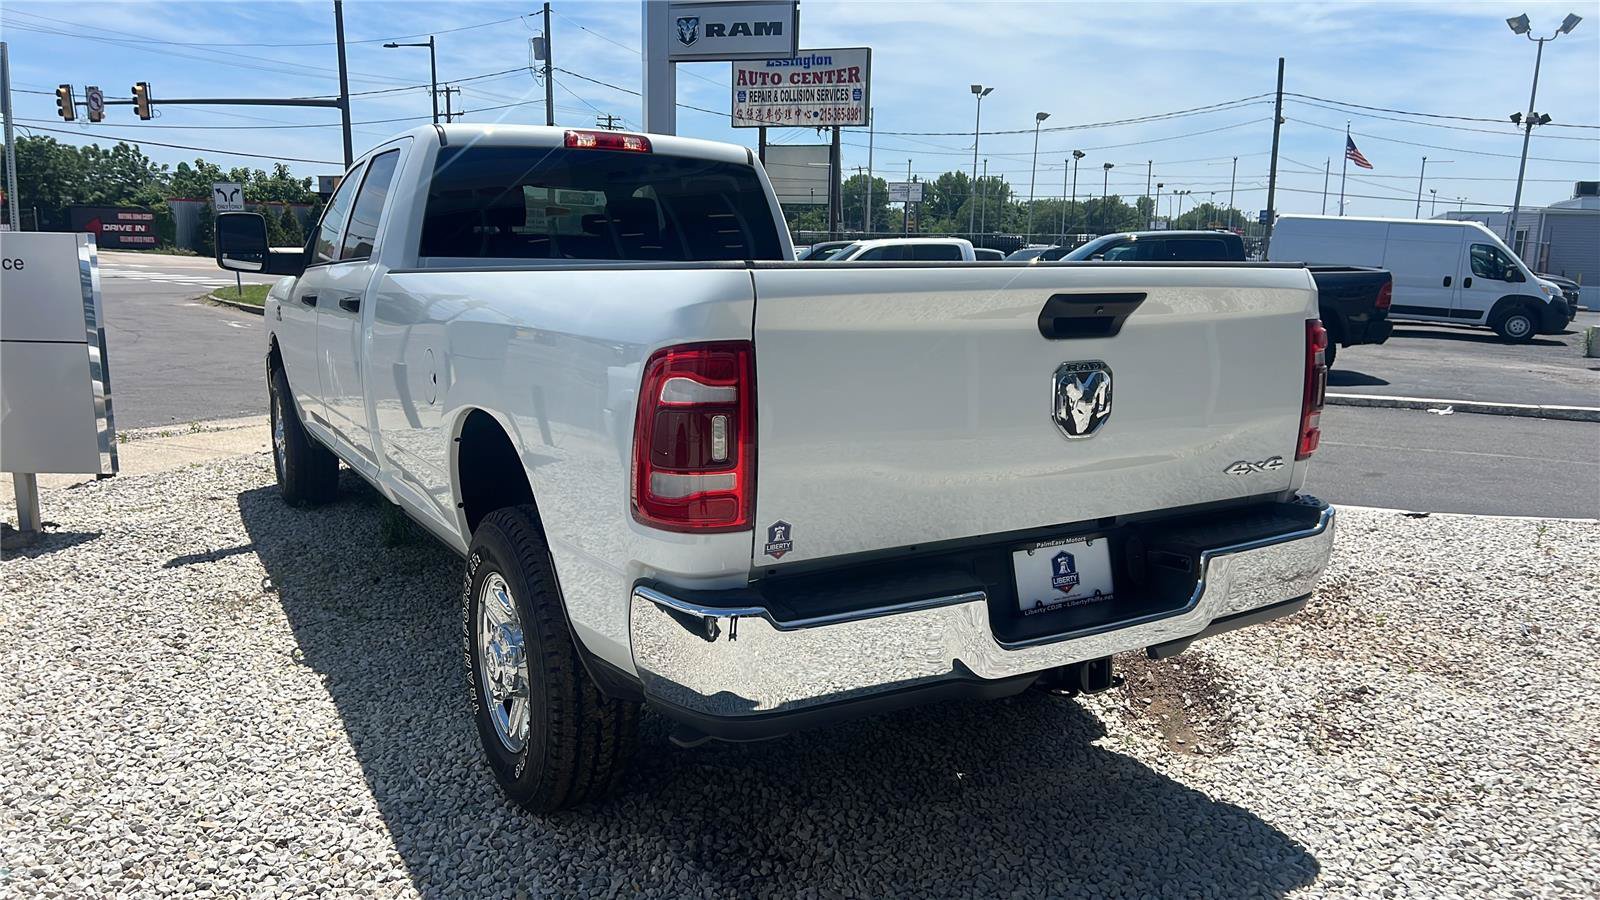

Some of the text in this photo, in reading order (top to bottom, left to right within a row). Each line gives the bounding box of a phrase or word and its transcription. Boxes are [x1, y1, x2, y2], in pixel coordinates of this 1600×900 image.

[705, 22, 783, 38] RAM
[737, 66, 861, 86] AUTO CENTER
[749, 90, 772, 102] REPAIR
[773, 90, 779, 102] &
[780, 89, 815, 102] COLLISION
[816, 88, 849, 102] SERVICES
[102, 224, 132, 232] DRIVE
[766, 542, 791, 551] LIBERTY
[1036, 536, 1086, 549] PalmEasy Motors
[1053, 574, 1078, 585] LIBERTY
[1024, 606, 1047, 616] Liberty
[462, 571, 480, 715] TRANSFORCE
